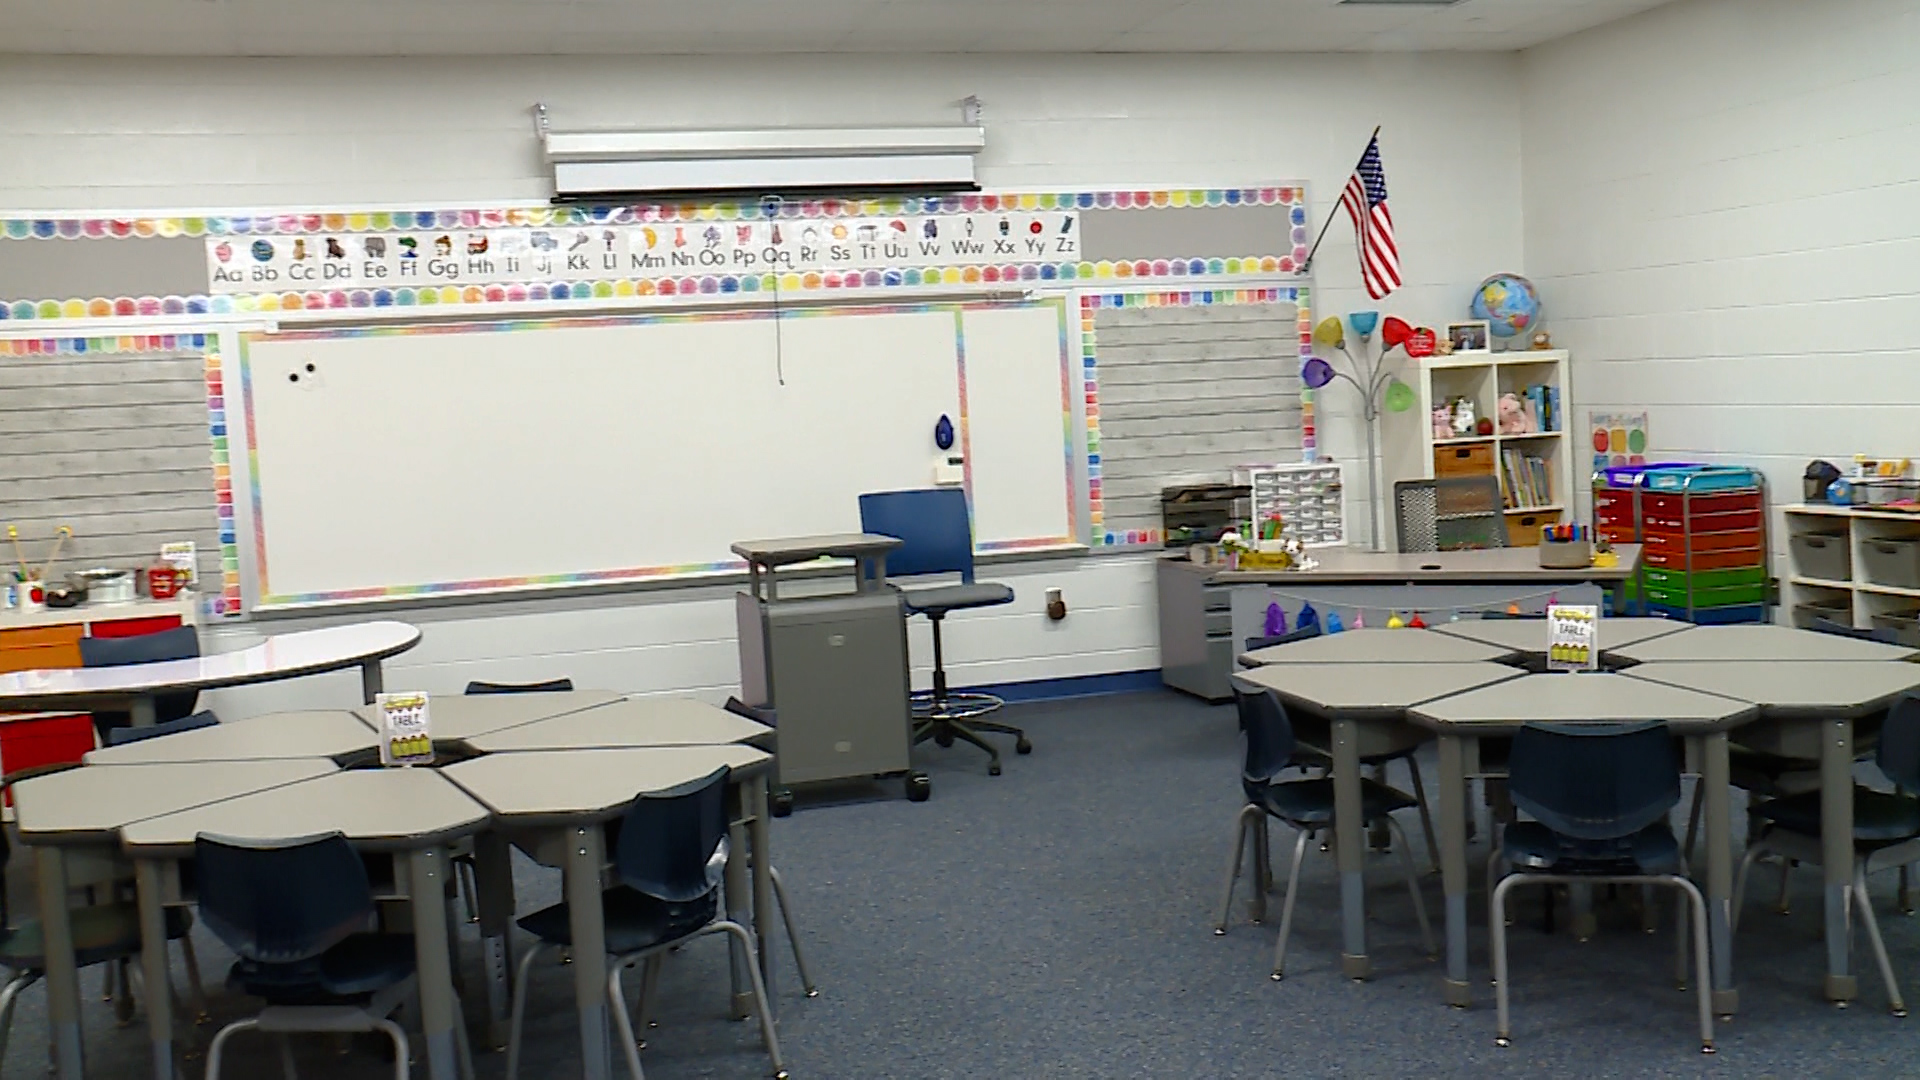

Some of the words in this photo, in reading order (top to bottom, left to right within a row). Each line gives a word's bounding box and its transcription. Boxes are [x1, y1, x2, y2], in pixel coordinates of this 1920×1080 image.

[213, 266, 243, 282] Aa
[289, 264, 316, 280] Cc
[323, 262, 351, 279] Dd
[364, 261, 388, 278] Ee
[400, 260, 418, 276] Ff
[428, 259, 459, 279] Gg
[467, 258, 495, 274] Hh
[567, 255, 590, 270] Kk
[631, 253, 665, 268] Mm
[672, 251, 695, 266] Nn
[699, 250, 725, 266] Oo
[733, 251, 756, 268] Pp
[762, 247, 795, 269] Qq
[801, 246, 818, 262] Rr
[830, 245, 850, 260] Ss
[861, 245, 876, 259] Tt
[884, 243, 908, 259] Uu
[919, 242, 941, 256] Vv
[952, 241, 984, 255] Ww
[994, 240, 1015, 254] Xx
[1025, 239, 1046, 256] Yy
[1056, 237, 1075, 252] Zz
